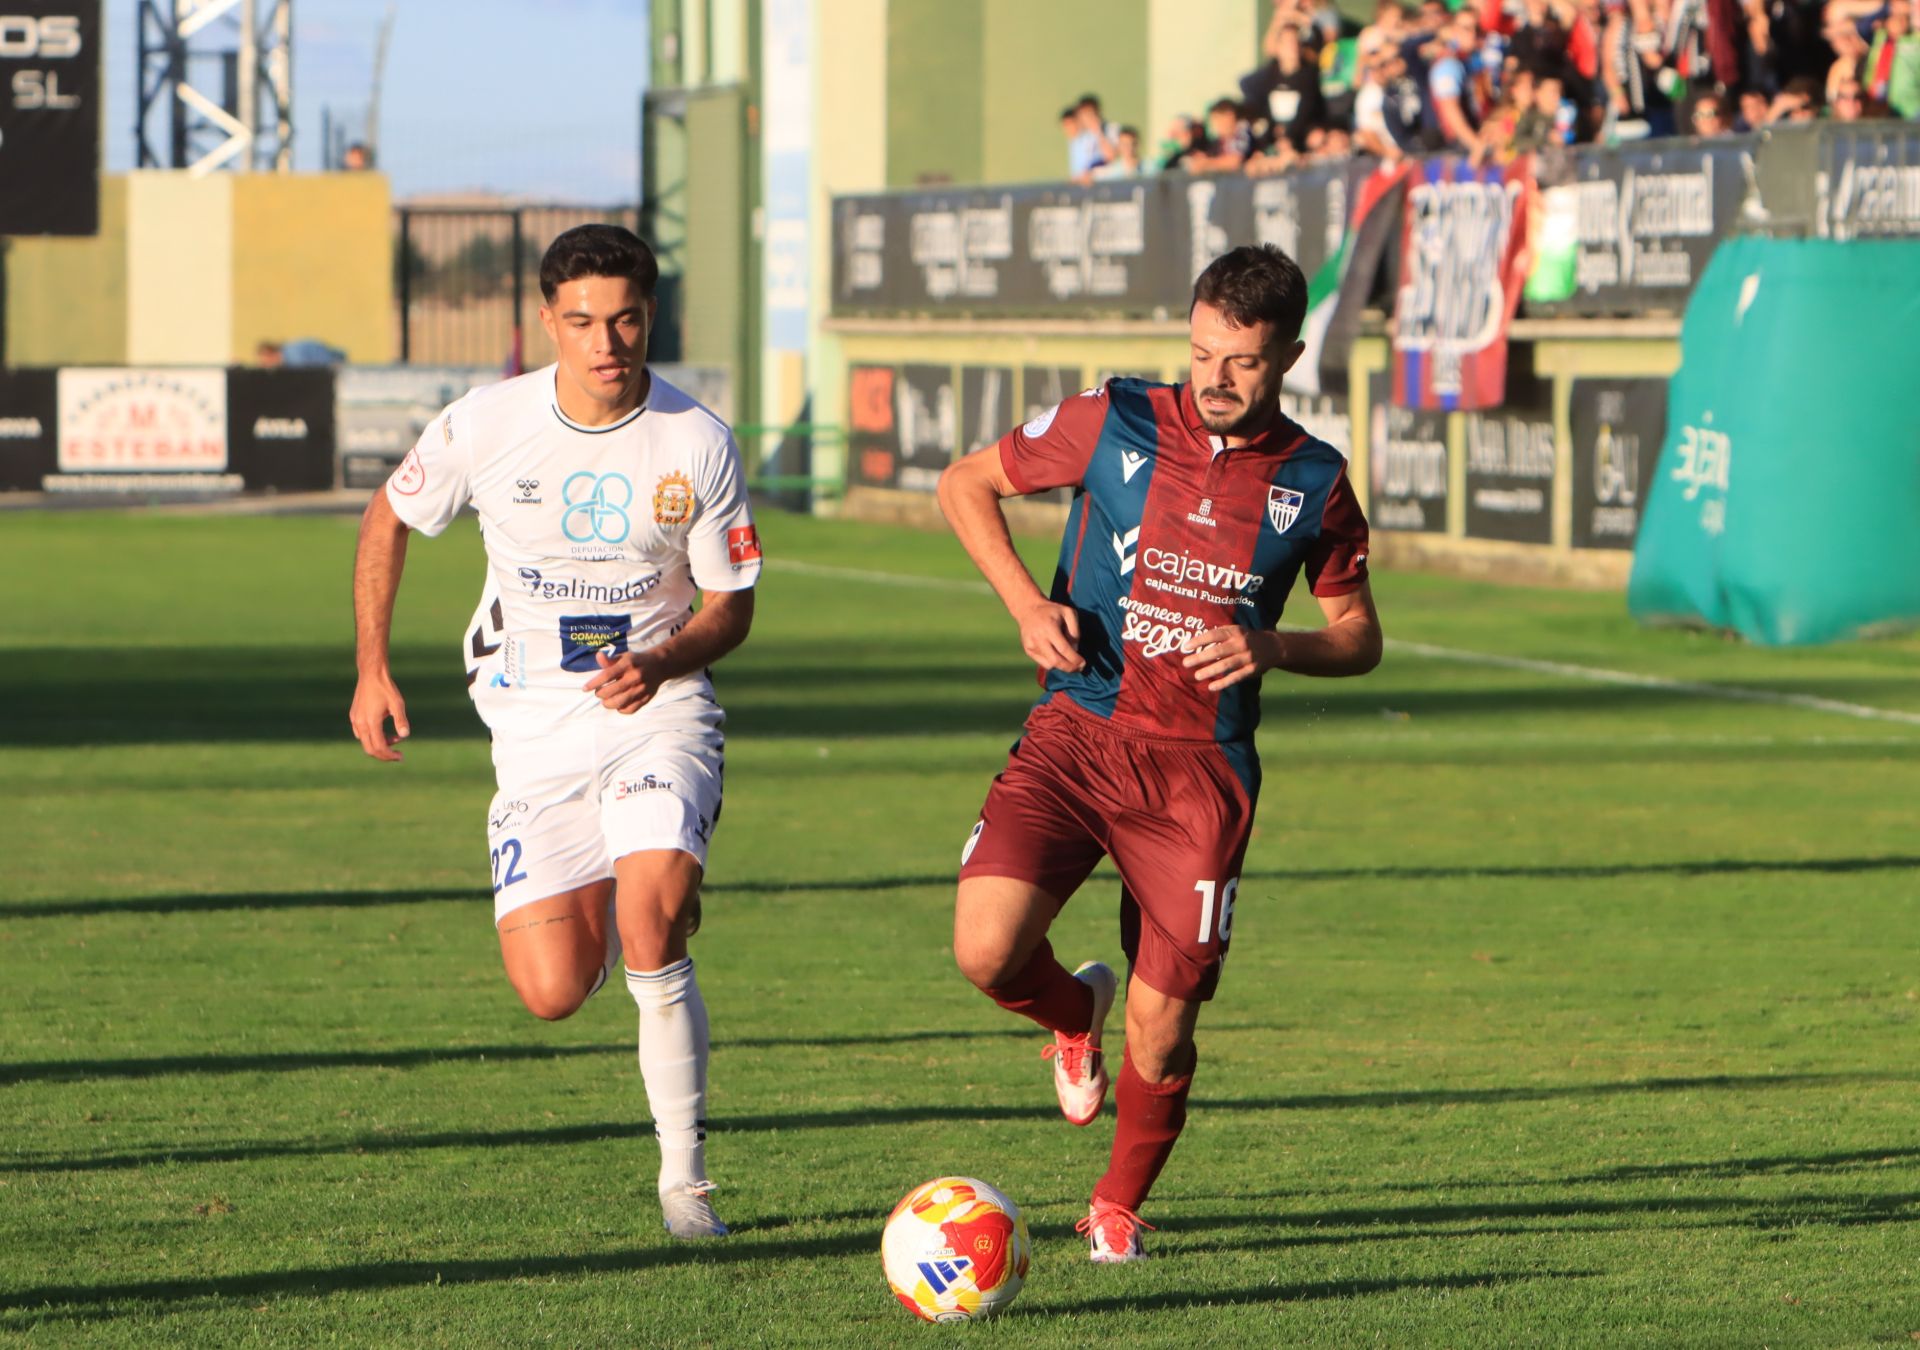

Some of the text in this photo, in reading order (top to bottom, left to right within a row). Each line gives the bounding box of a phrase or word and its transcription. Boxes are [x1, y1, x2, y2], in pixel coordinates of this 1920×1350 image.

[513, 496, 542, 505] hummel
[1187, 512, 1216, 527] SEGOVIA
[1143, 547, 1264, 593] cajaviva
[1145, 577, 1255, 608] cajarural Fundación
[1118, 596, 1206, 630] amanece en
[491, 837, 528, 895] 22
[1194, 877, 1238, 943] 16
